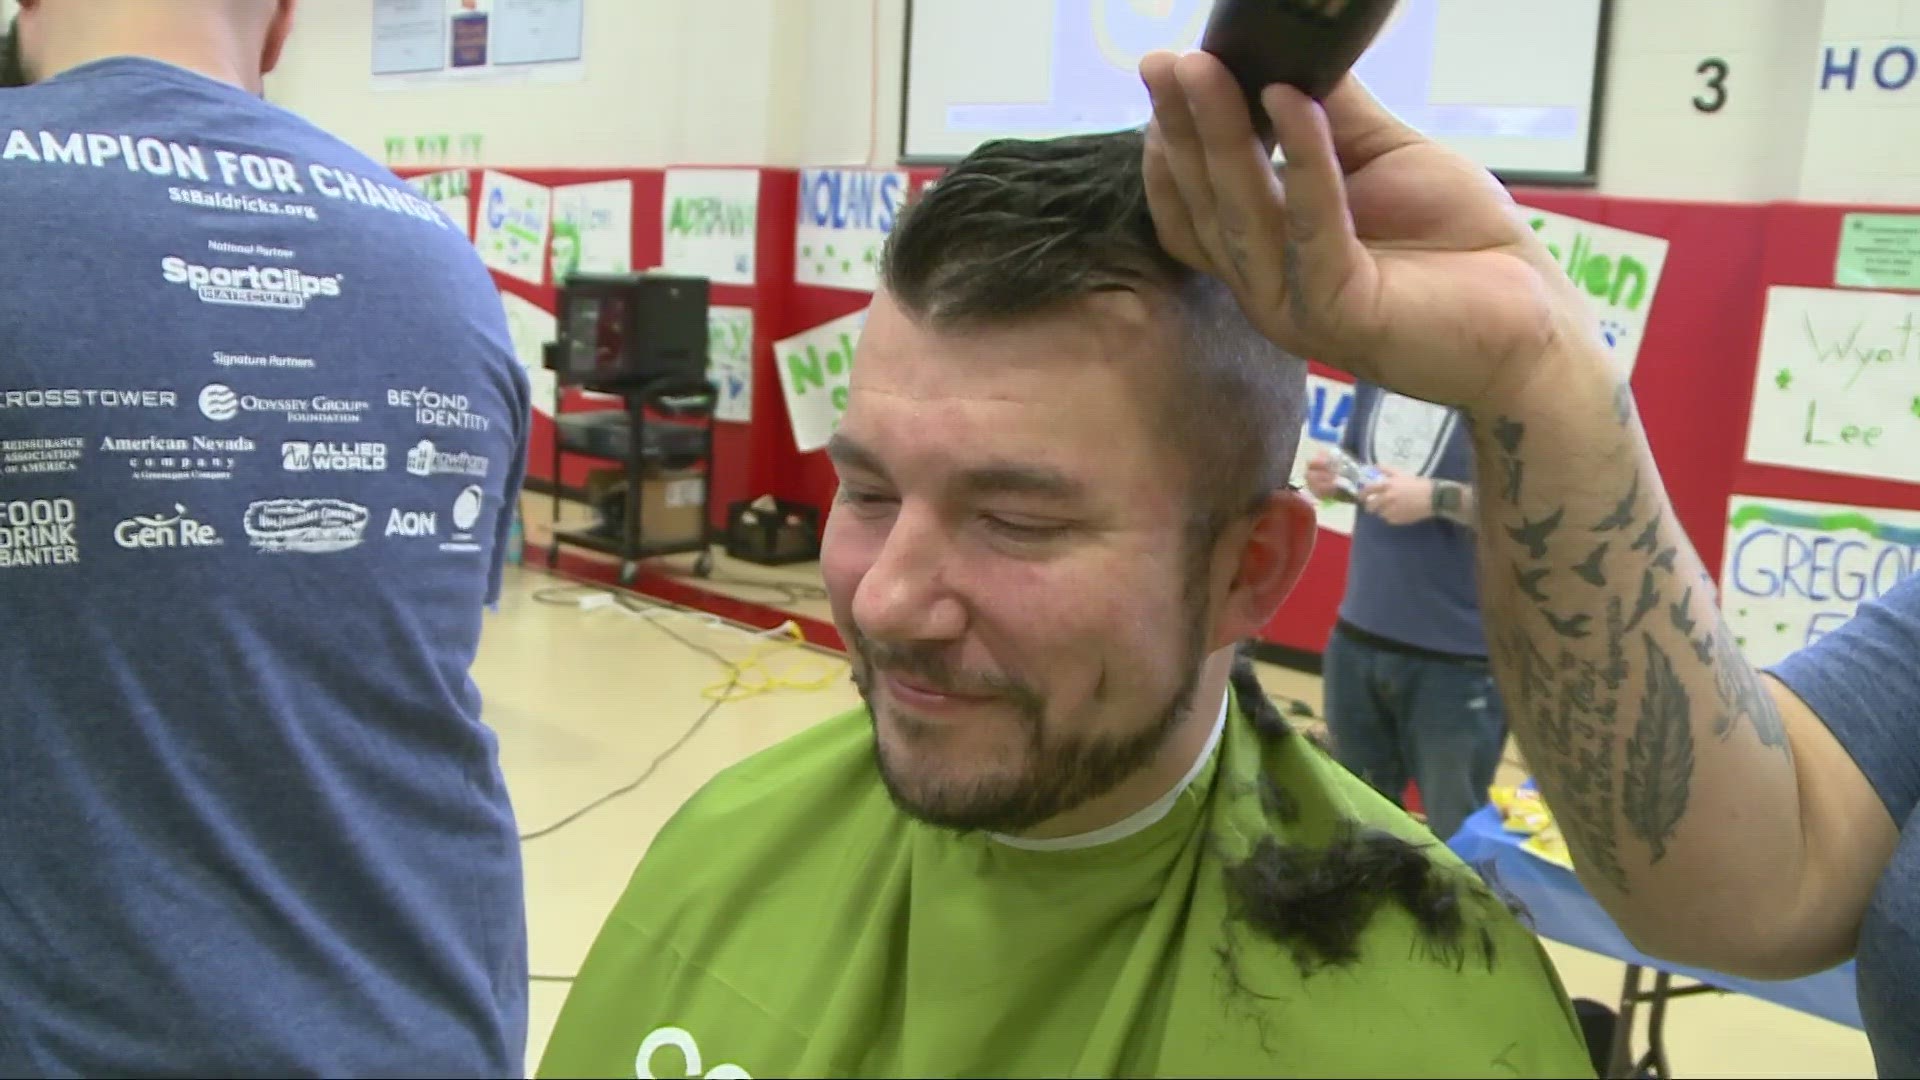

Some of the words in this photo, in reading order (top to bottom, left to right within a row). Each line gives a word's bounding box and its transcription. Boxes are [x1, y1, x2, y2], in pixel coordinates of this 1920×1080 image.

[1819, 46, 1918, 91] HO
[1691, 57, 1730, 114] 3
[3, 129, 210, 182] AMPION
[215, 150, 304, 195] FOR
[308, 163, 449, 231] CHANGE
[168, 186, 319, 221] StBaldricks.org
[208, 239, 254, 254] National
[256, 244, 296, 258] Partner
[162, 255, 341, 299] SportClips
[213, 351, 267, 366] Signature
[269, 355, 315, 368] Partners
[387, 386, 469, 411] BEYOND
[287, 411, 360, 423] FOUNDATION
[416, 406, 490, 431] IDENTITY
[1804, 400, 1883, 447] Lee
[100, 435, 189, 451] American
[192, 435, 256, 451] Nevada
[312, 441, 387, 456] ALLIED
[4, 449, 82, 463] ASSOCIATION
[21, 461, 77, 473] AMERICA
[312, 455, 388, 470] WORLD
[114, 519, 175, 548] Gen
[180, 519, 215, 547] Re
[385, 508, 436, 536] AON
